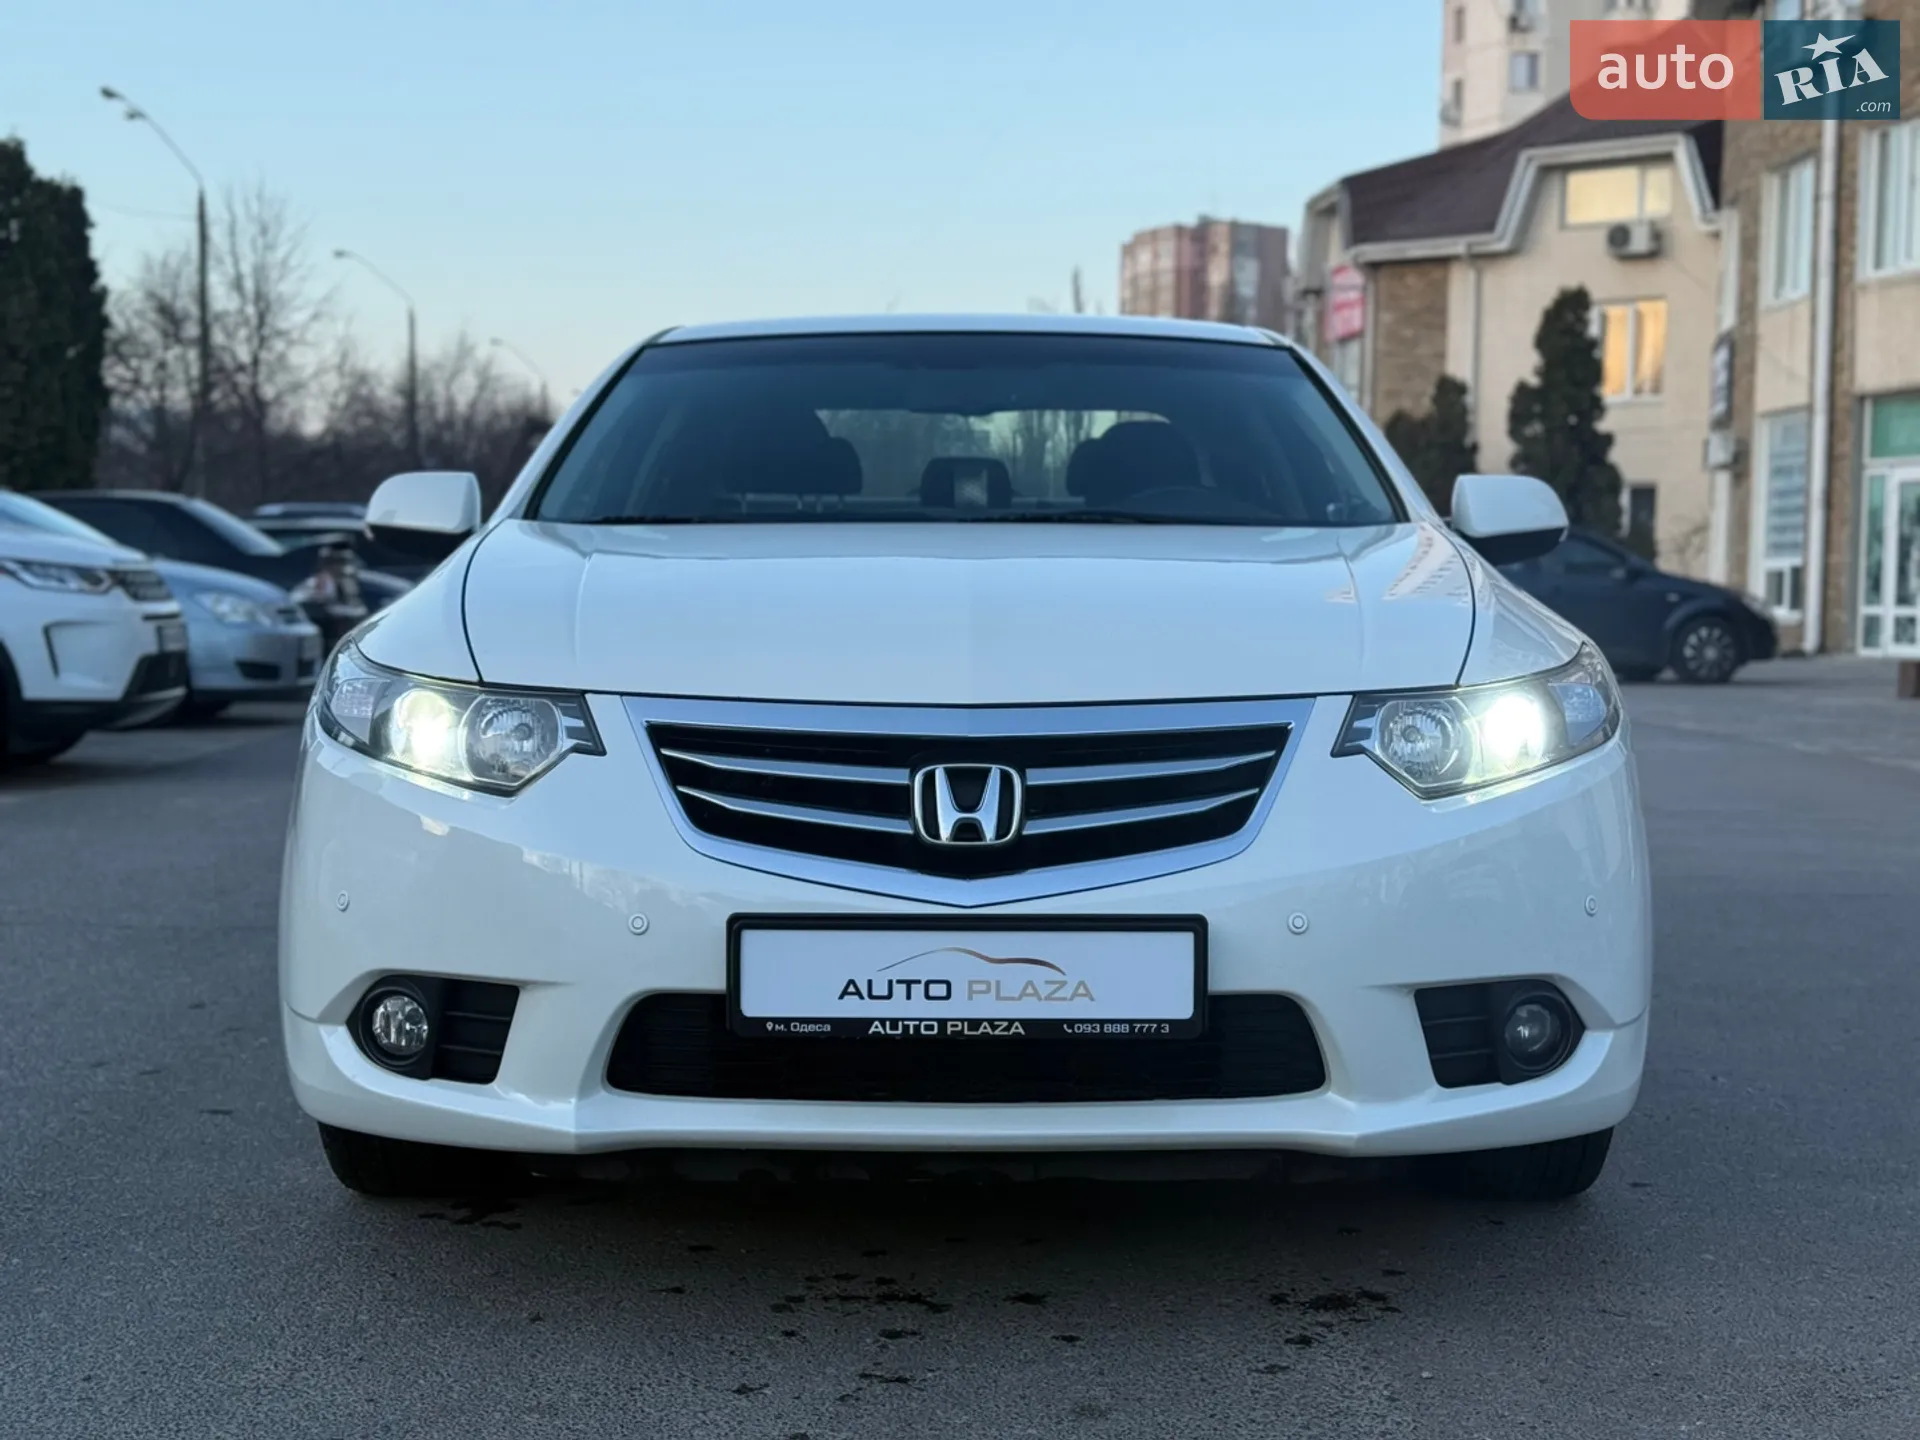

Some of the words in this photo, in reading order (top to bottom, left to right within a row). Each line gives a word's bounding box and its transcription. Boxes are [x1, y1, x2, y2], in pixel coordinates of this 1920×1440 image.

[837, 978, 952, 1001] AUTO
[967, 979, 1096, 1002] PLAZA
[790, 1022, 832, 1033] Одеса
[868, 1020, 939, 1035] AUTO
[946, 1021, 1026, 1036] PLAZA
[1073, 1023, 1101, 1034] 093
[1103, 1023, 1130, 1034] 888
[1132, 1023, 1158, 1034] 777
[1160, 1023, 1170, 1034] 3
